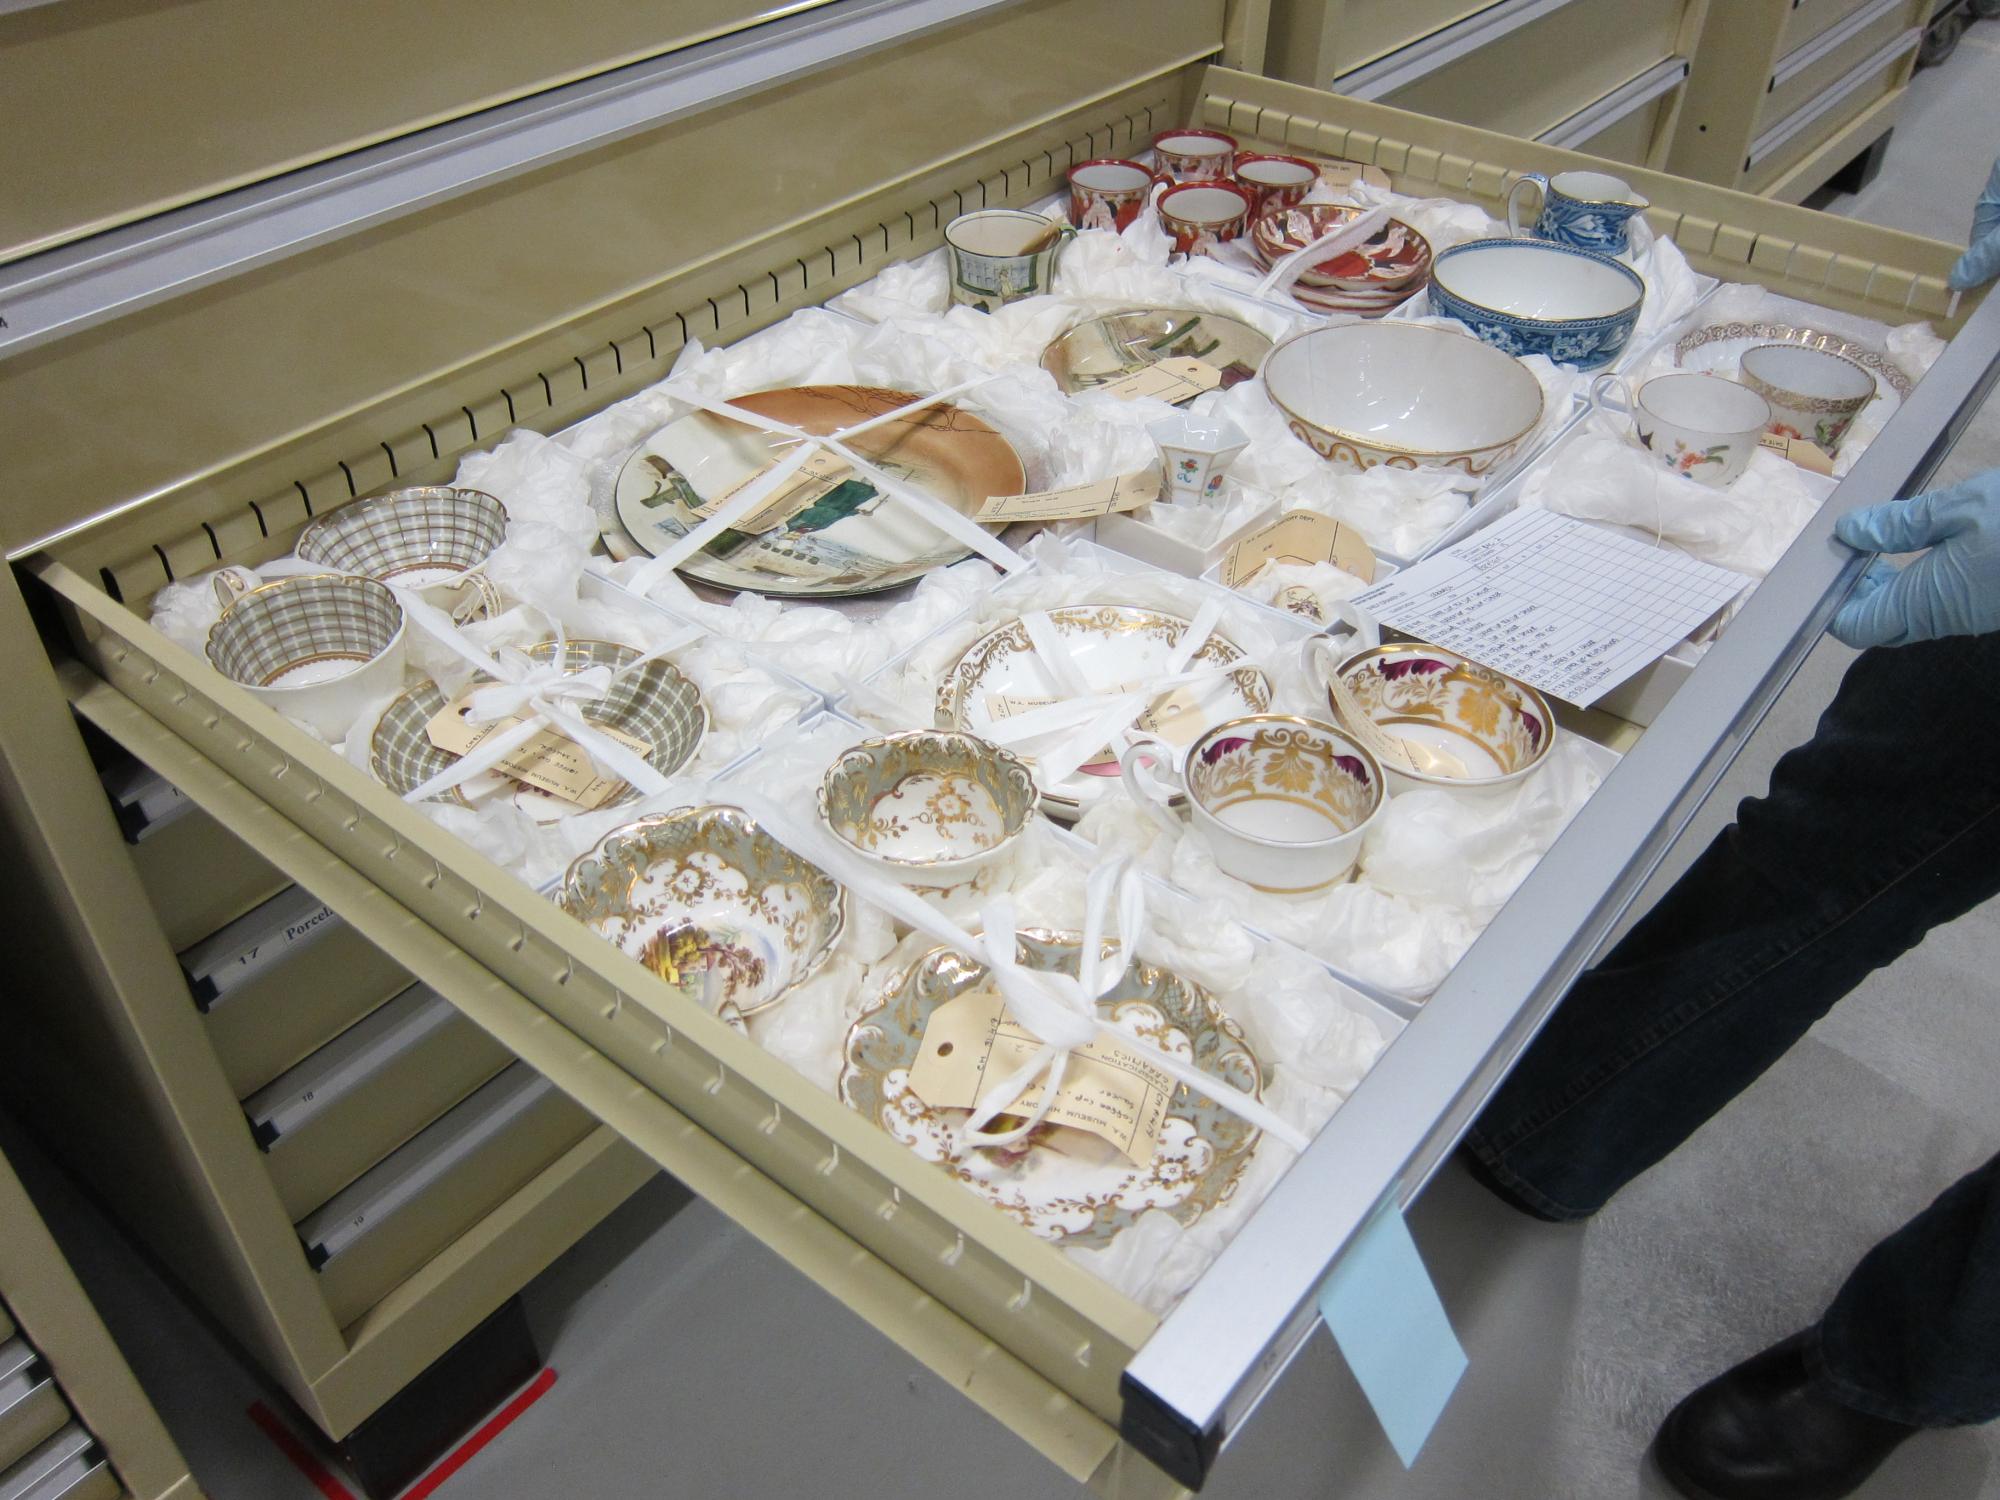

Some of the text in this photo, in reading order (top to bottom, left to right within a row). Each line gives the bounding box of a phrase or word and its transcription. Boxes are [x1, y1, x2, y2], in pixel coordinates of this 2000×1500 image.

[239, 906, 334, 965] 17 Porcel
[1065, 1109, 1107, 1127] MUSEUM
